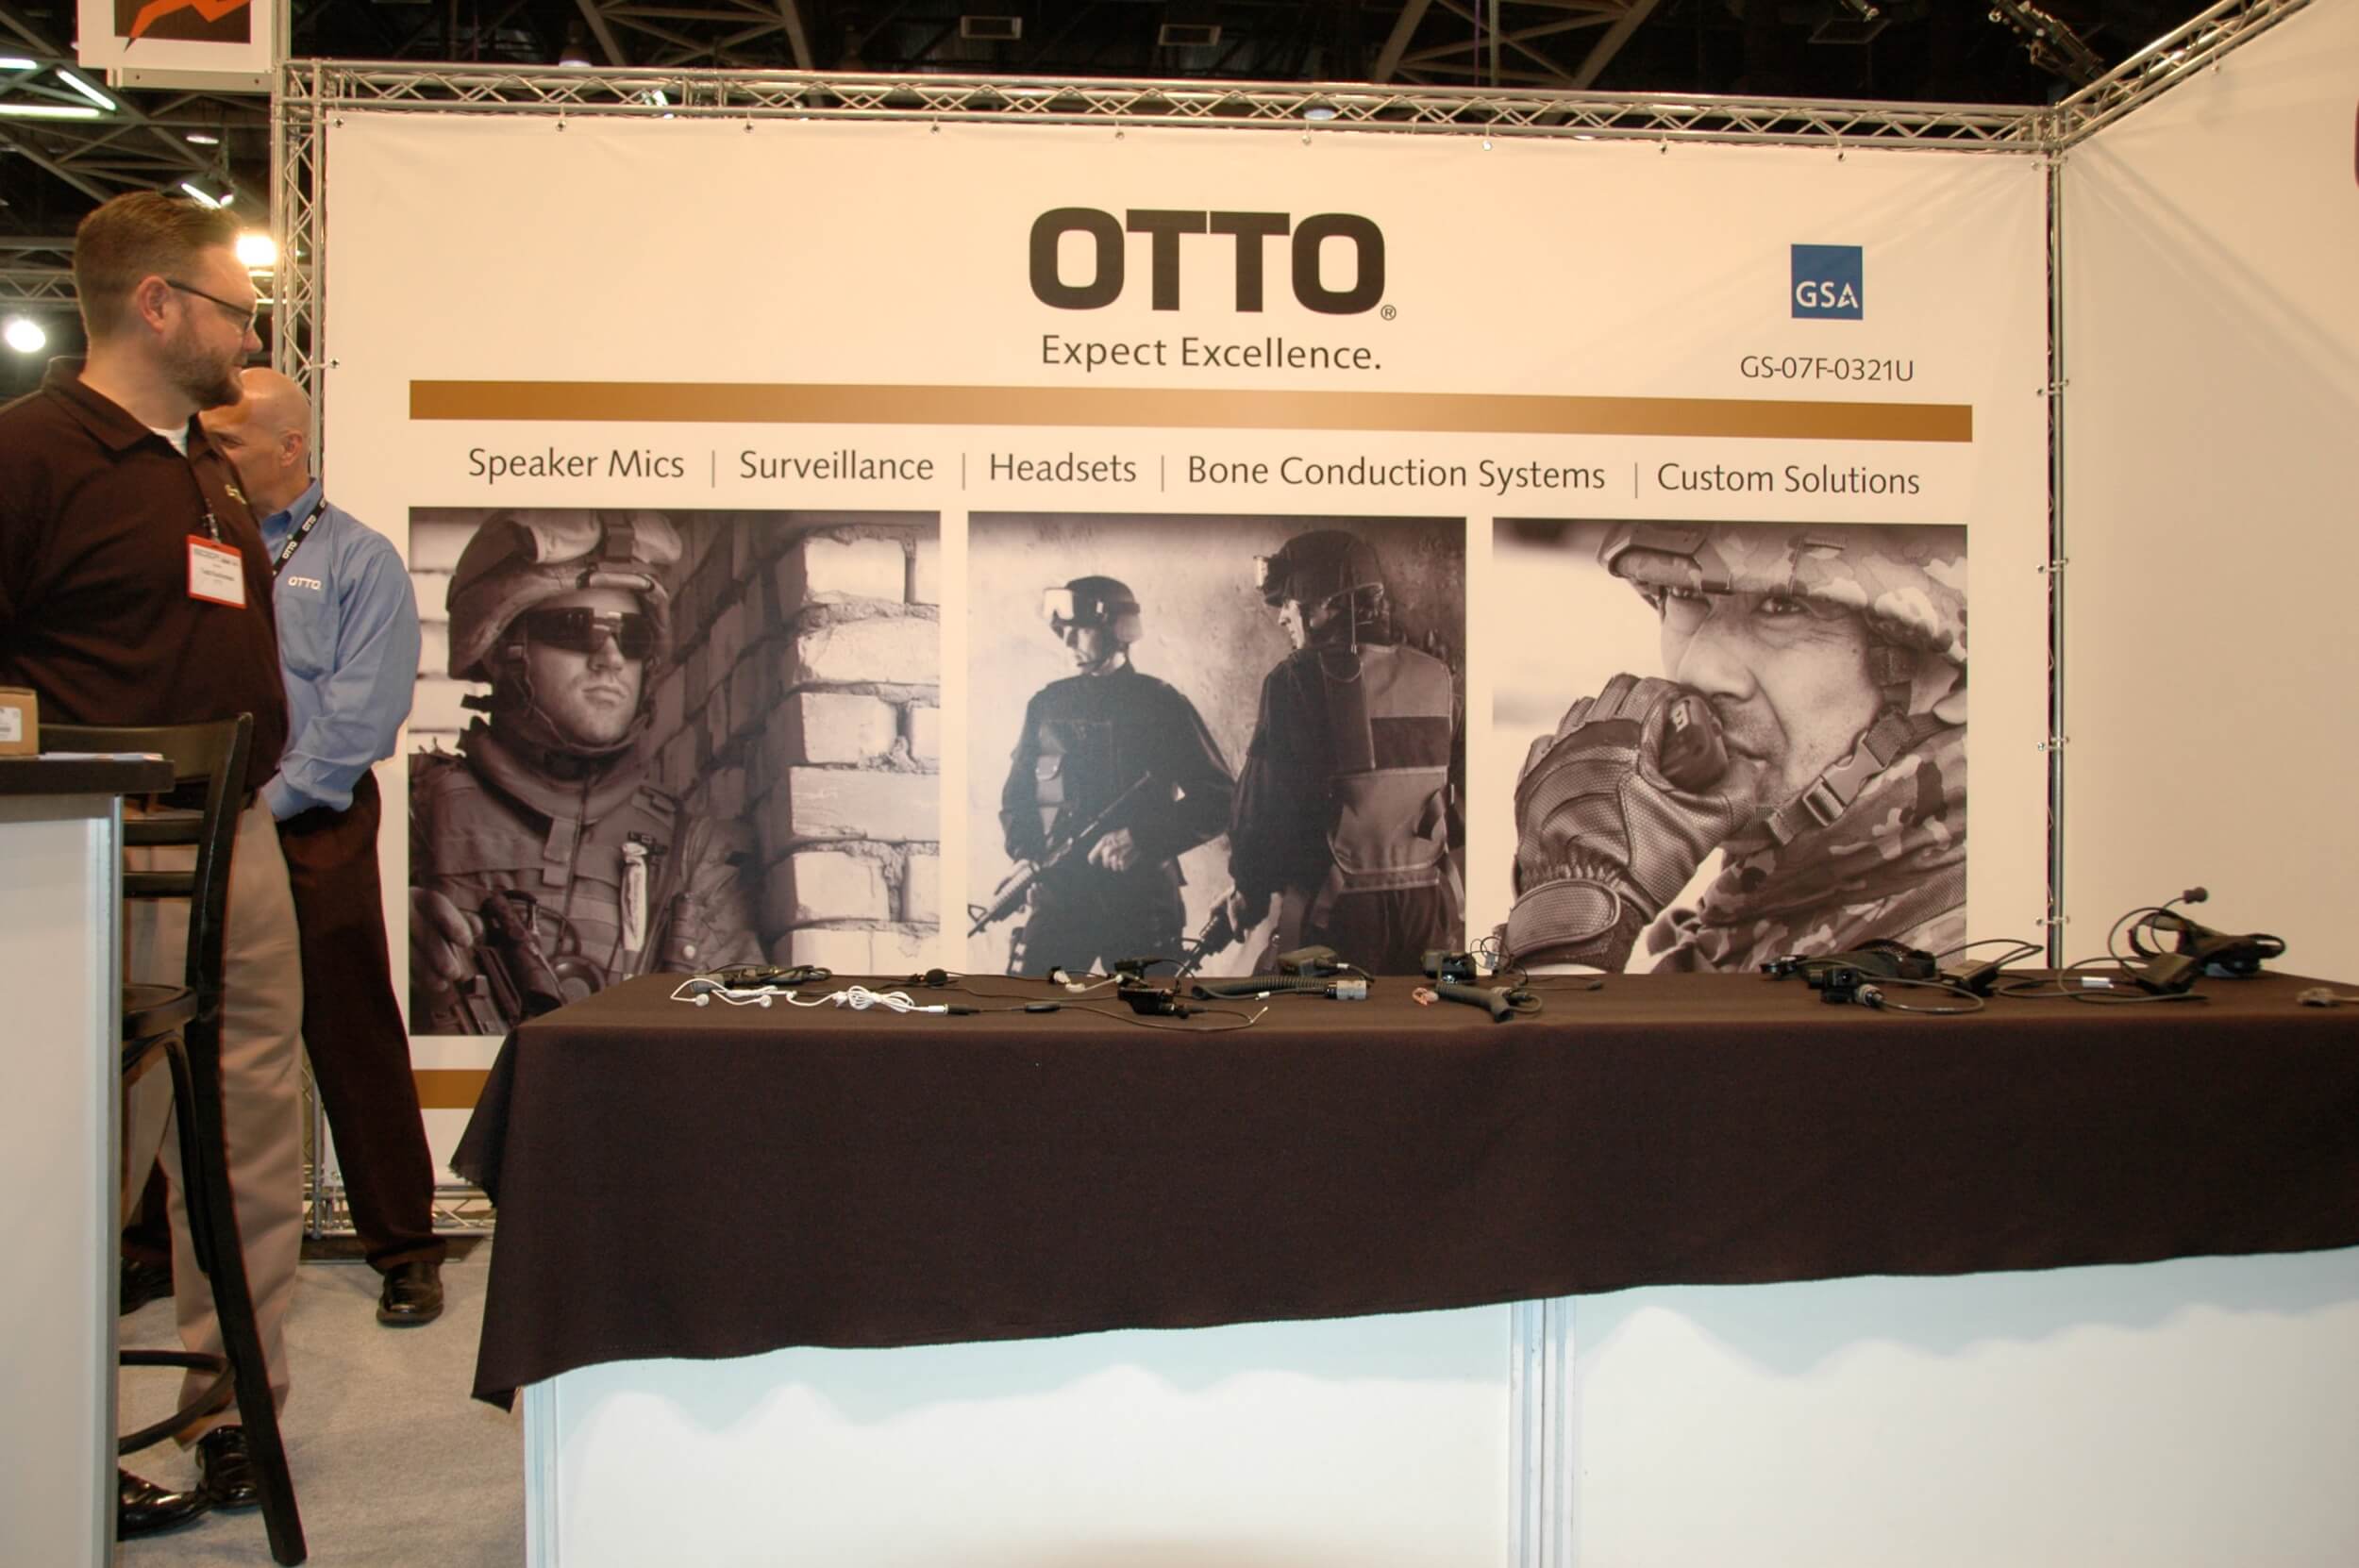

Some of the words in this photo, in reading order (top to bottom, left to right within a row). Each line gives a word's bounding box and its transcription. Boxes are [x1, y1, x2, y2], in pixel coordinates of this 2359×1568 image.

[1796, 280, 1858, 309] GSA
[1042, 334, 1167, 373] Expect
[1181, 336, 1381, 370] Excellence.
[1740, 355, 1914, 382] GS-07F-0321U
[469, 447, 599, 485] Speaker
[609, 449, 685, 478] Mics
[740, 450, 934, 480] Surveillance
[990, 452, 1137, 483] Headsets
[1189, 456, 1269, 484] Bone
[1280, 457, 1467, 487] Conduction
[1479, 459, 1605, 496] Systems
[1658, 462, 1774, 492] Custom
[1784, 463, 1920, 495] Solutions
[282, 541, 297, 559] OTTO
[288, 576, 321, 590] OTTO
